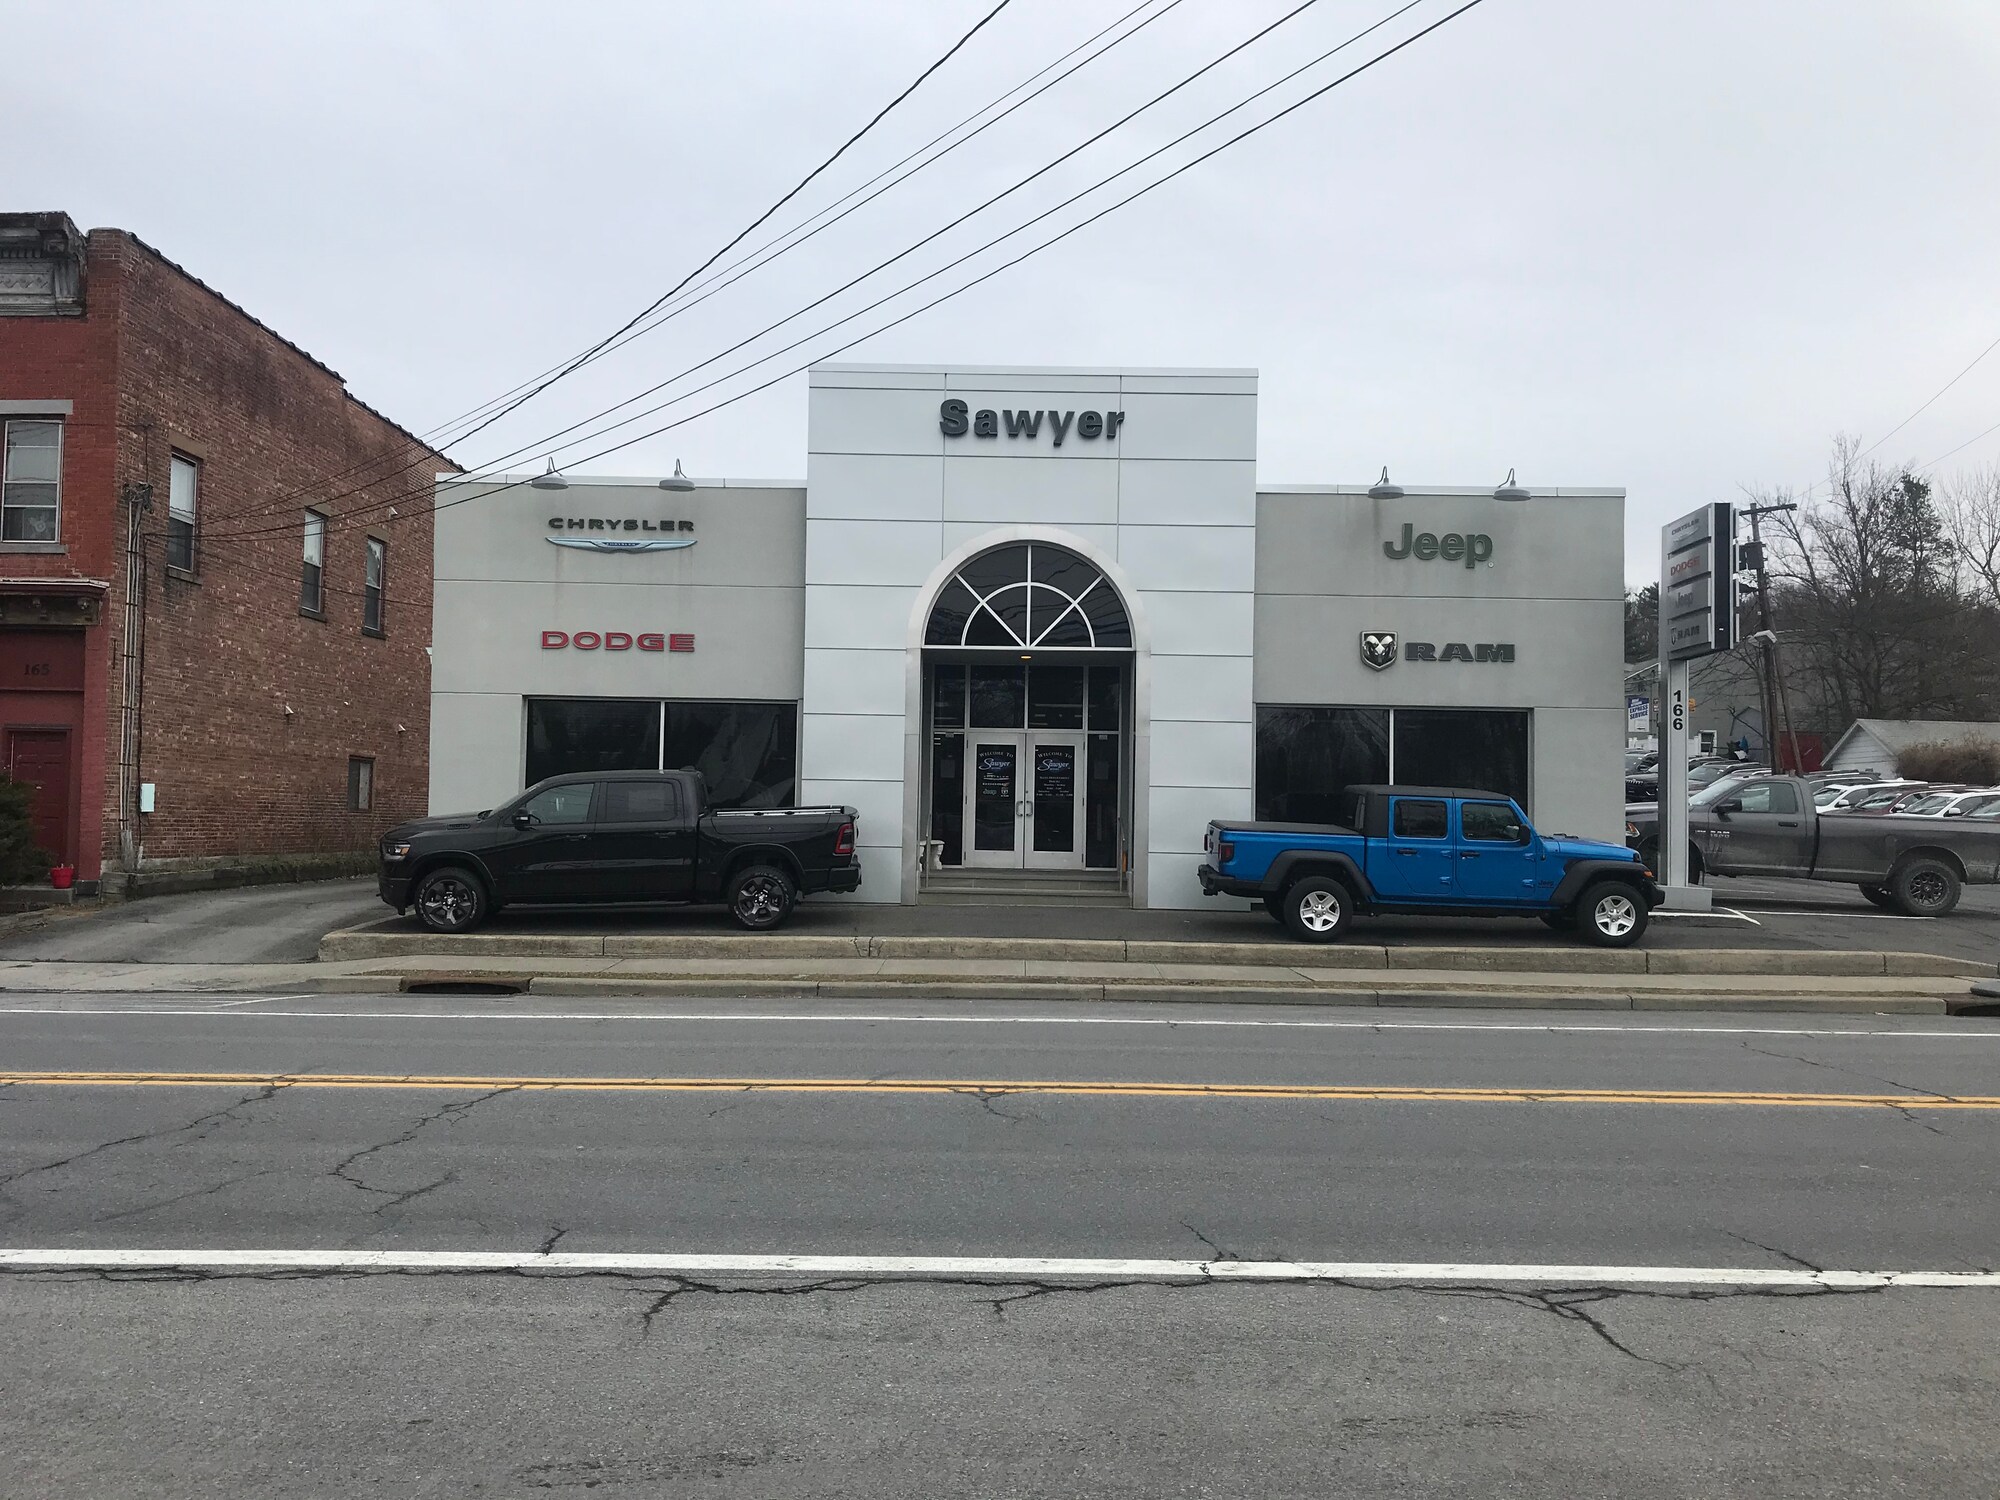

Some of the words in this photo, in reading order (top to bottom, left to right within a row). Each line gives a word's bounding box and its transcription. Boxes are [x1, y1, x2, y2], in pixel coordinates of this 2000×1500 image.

[939, 398, 1125, 447] Sawyer
[548, 517, 695, 531] CHRYSLER
[1671, 518, 1700, 536] CHRYSLER
[1383, 523, 1493, 569] Jeep
[1670, 556, 1700, 577] DODGE
[1675, 591, 1694, 608] Jeep
[1677, 625, 1700, 641] RAM
[541, 630, 696, 653] DODGE
[1405, 642, 1515, 663] RAM
[24, 663, 50, 676] 165
[1629, 704, 1649, 714] EXPRESS
[1629, 711, 1649, 720] SERVICE
[978, 757, 1011, 770] Sawyer
[1037, 758, 1070, 771] Sawyer
